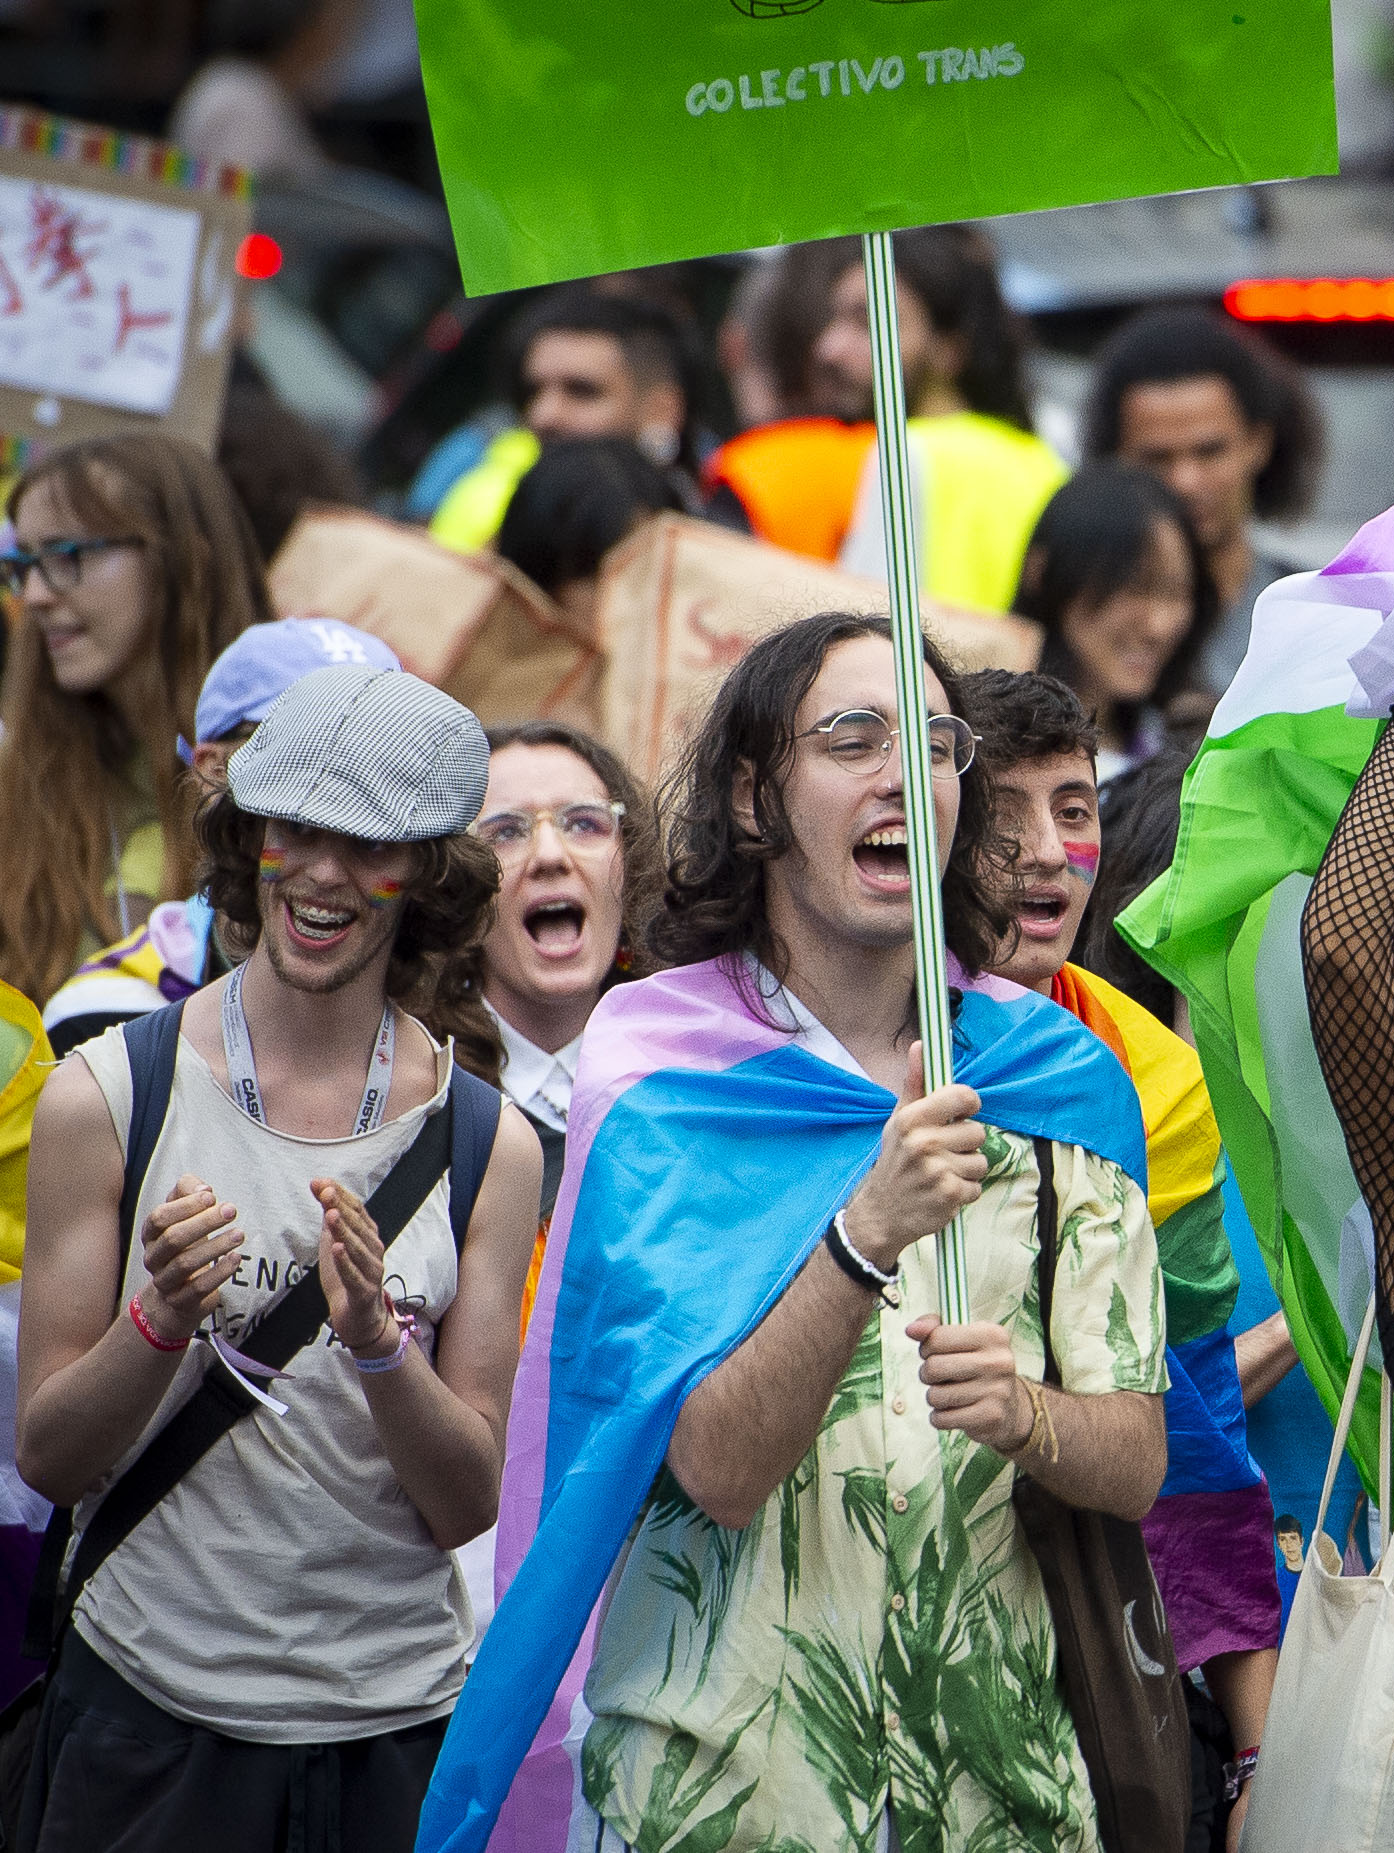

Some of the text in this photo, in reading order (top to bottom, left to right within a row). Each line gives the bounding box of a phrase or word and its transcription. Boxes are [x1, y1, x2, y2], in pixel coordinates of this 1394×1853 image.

[685, 42, 1026, 117] COLECTIVO TRANS
[310, 623, 368, 664] LA
[241, 1078, 262, 1124] CASI
